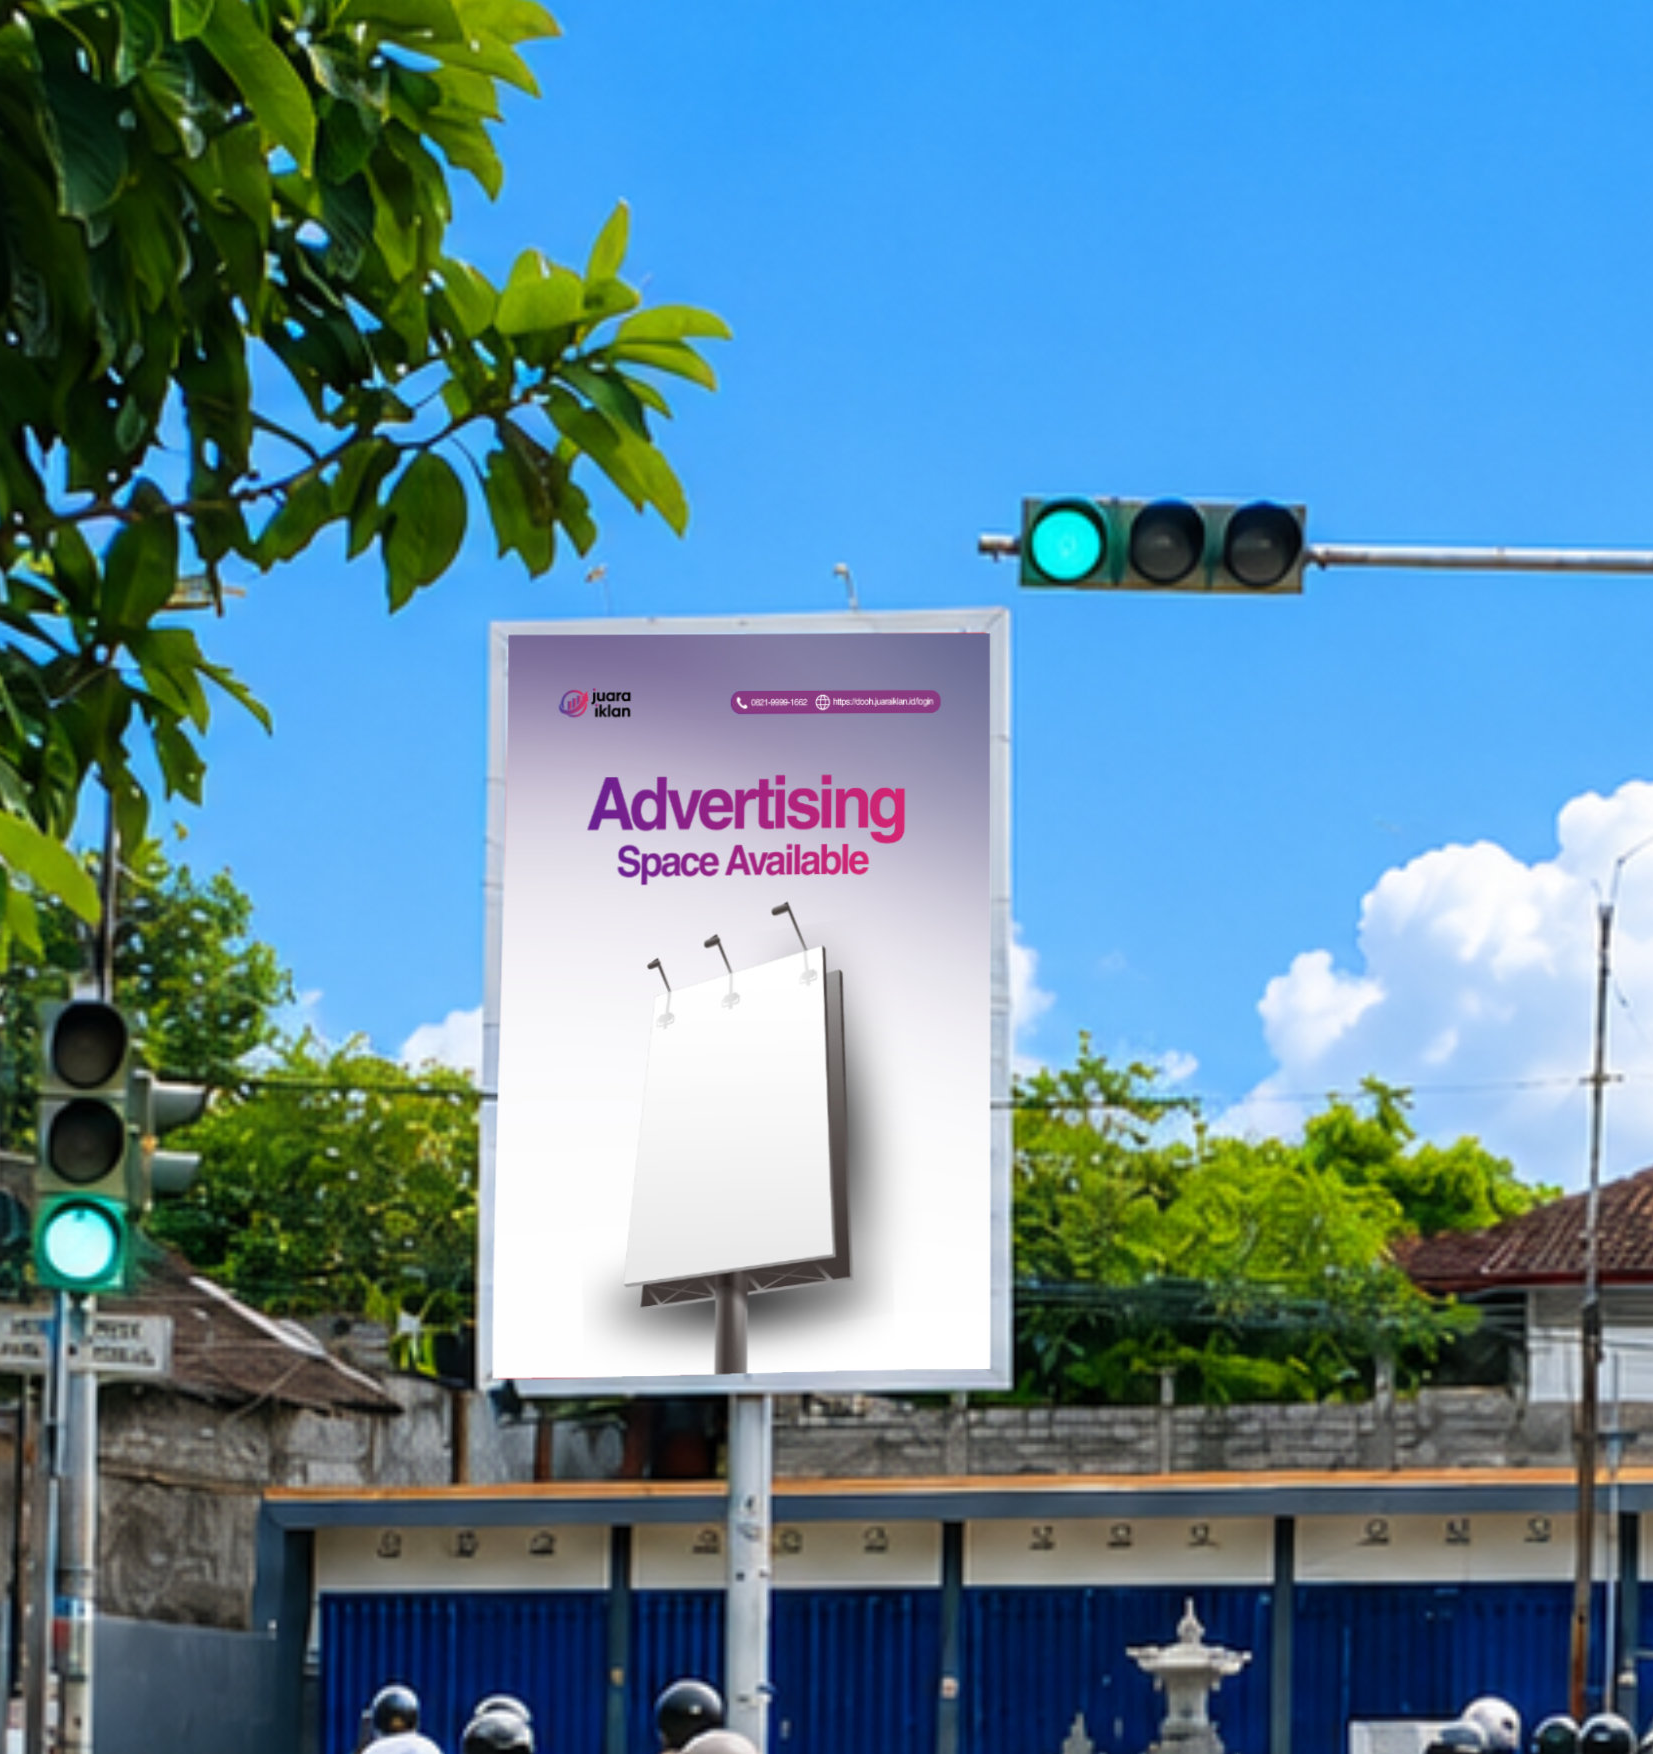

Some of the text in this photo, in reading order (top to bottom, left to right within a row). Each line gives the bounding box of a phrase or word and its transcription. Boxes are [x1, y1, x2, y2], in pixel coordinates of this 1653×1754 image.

[591, 688, 631, 705] juara
[594, 703, 631, 718] iklan
[587, 774, 905, 844] Advertising
[617, 843, 869, 885] Space Available
